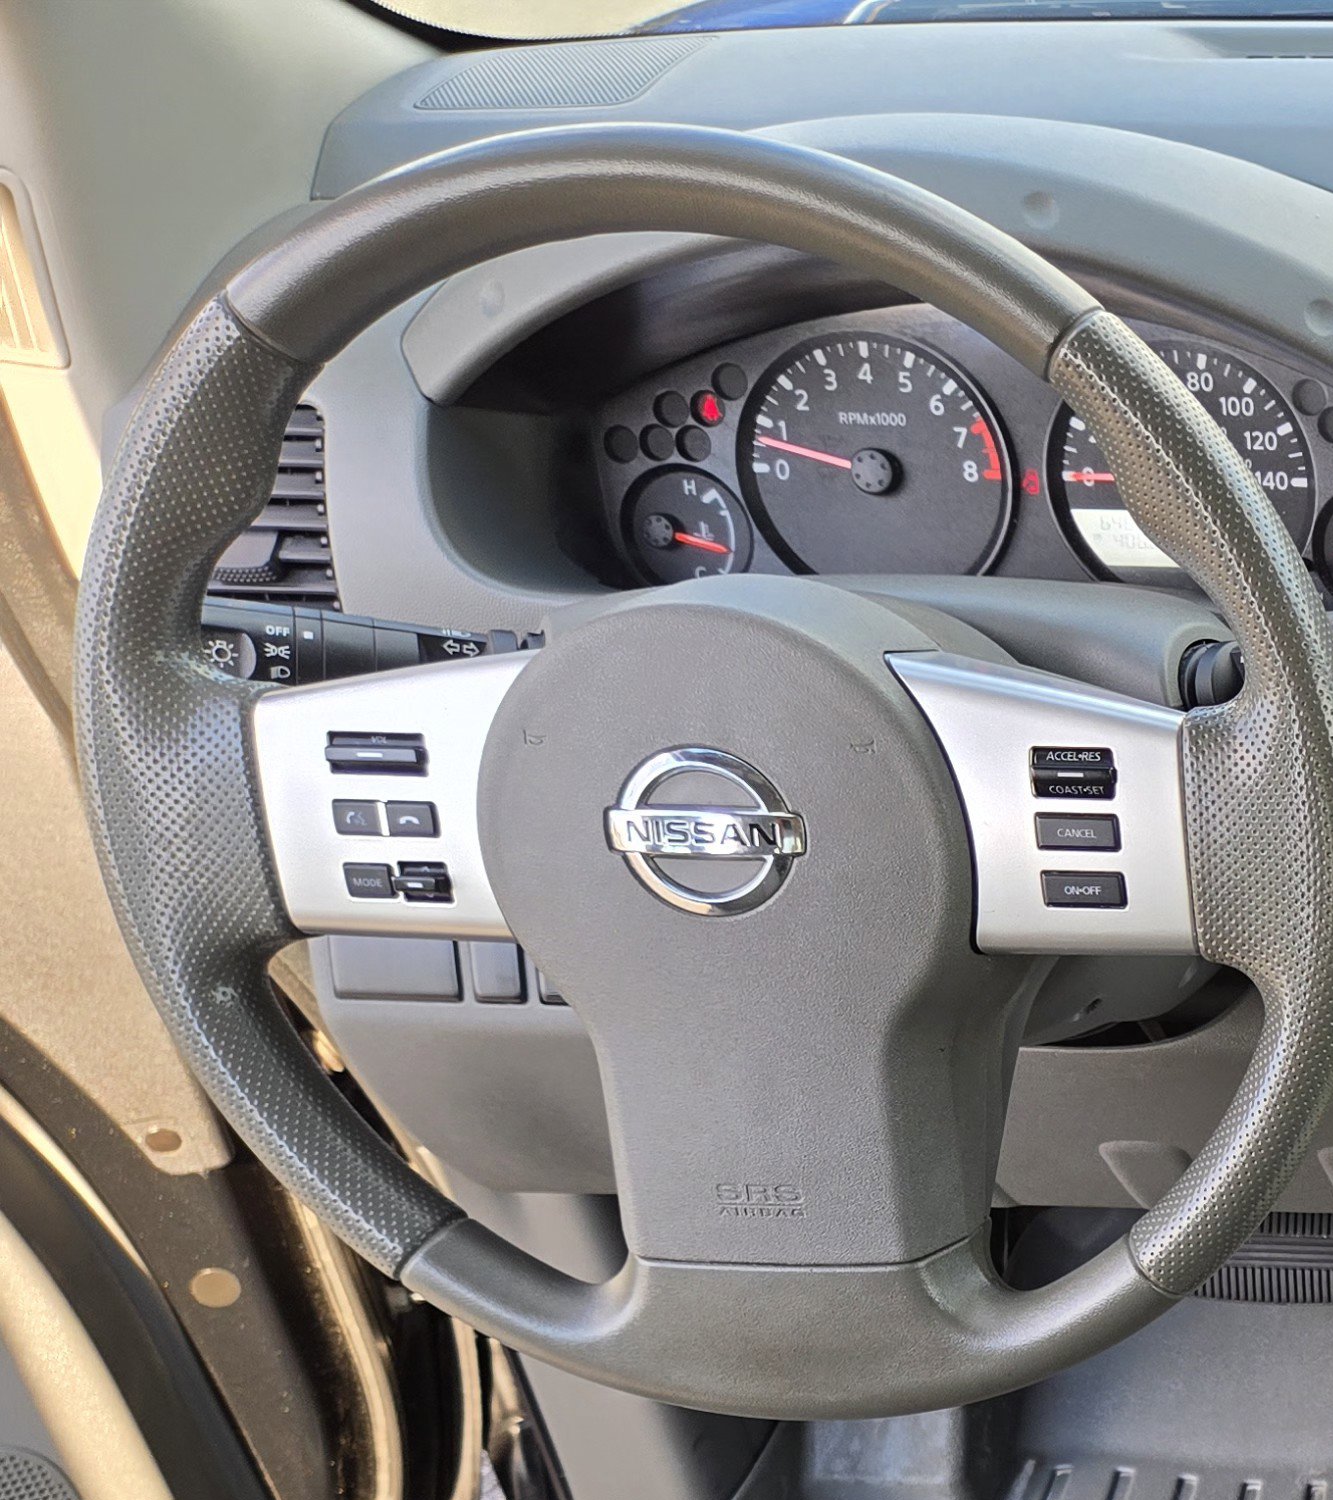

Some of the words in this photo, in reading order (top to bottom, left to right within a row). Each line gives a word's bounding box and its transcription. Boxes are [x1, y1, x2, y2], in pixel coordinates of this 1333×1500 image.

[823, 368, 838, 391] 3
[857, 361, 873, 385] 4
[897, 370, 913, 394] 5
[1186, 371, 1214, 392] 80
[794, 388, 811, 412] 2
[929, 396, 945, 416] 6
[1218, 396, 1255, 417] 100
[777, 420, 788, 440] 1
[837, 411, 908, 428] RPMx1000
[952, 427, 969, 449] 7
[1243, 430, 1278, 451] 120
[775, 458, 790, 481] 0
[962, 460, 979, 483] 8
[682, 478, 697, 497] H
[265, 624, 291, 638] OFF
[626, 819, 785, 848] NISSAN
[1056, 828, 1098, 839] CANCEL
[352, 876, 383, 888] MODE
[715, 1183, 801, 1202] SRS
